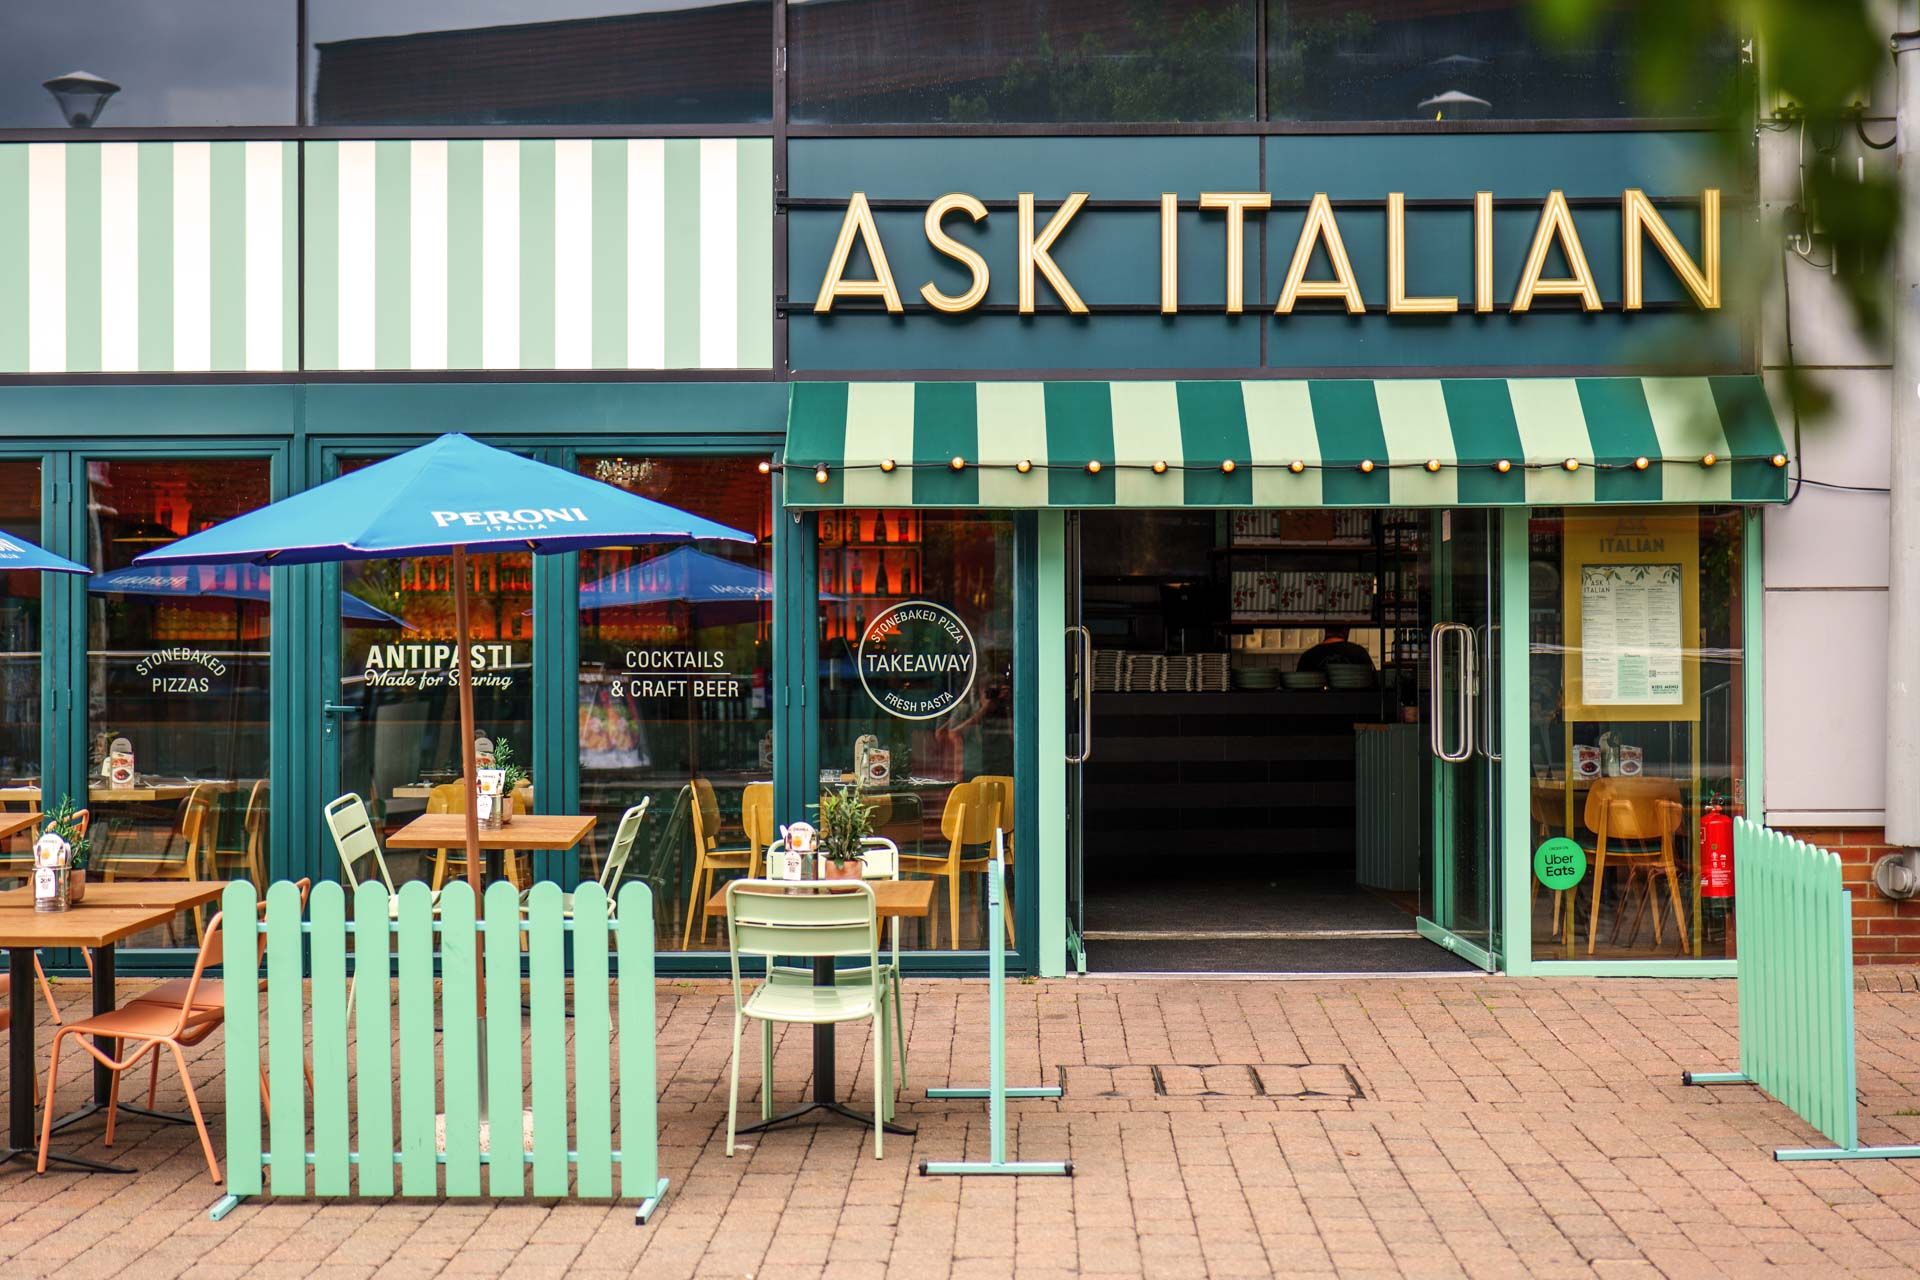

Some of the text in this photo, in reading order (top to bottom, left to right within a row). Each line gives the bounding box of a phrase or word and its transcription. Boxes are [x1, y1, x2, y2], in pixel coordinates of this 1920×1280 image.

[813, 188, 1721, 316] ASK ITALIAN
[431, 507, 589, 528] PERONI
[486, 523, 548, 533] ITALIA
[1600, 538, 1665, 553] ITALIAN
[871, 609, 964, 645] STONEBAKED PIZZA
[135, 647, 227, 677] STONEBAKED
[626, 650, 725, 669] COCKTAILS
[866, 654, 971, 672] TAKEAWAY
[152, 677, 209, 693] PIZZAS
[364, 668, 514, 690] Made for Saring
[611, 680, 739, 698] & CRAFT BEER
[884, 691, 954, 712] FRESH PASTA
[1544, 854, 1574, 865] Uber
[1546, 865, 1576, 877] Eats
